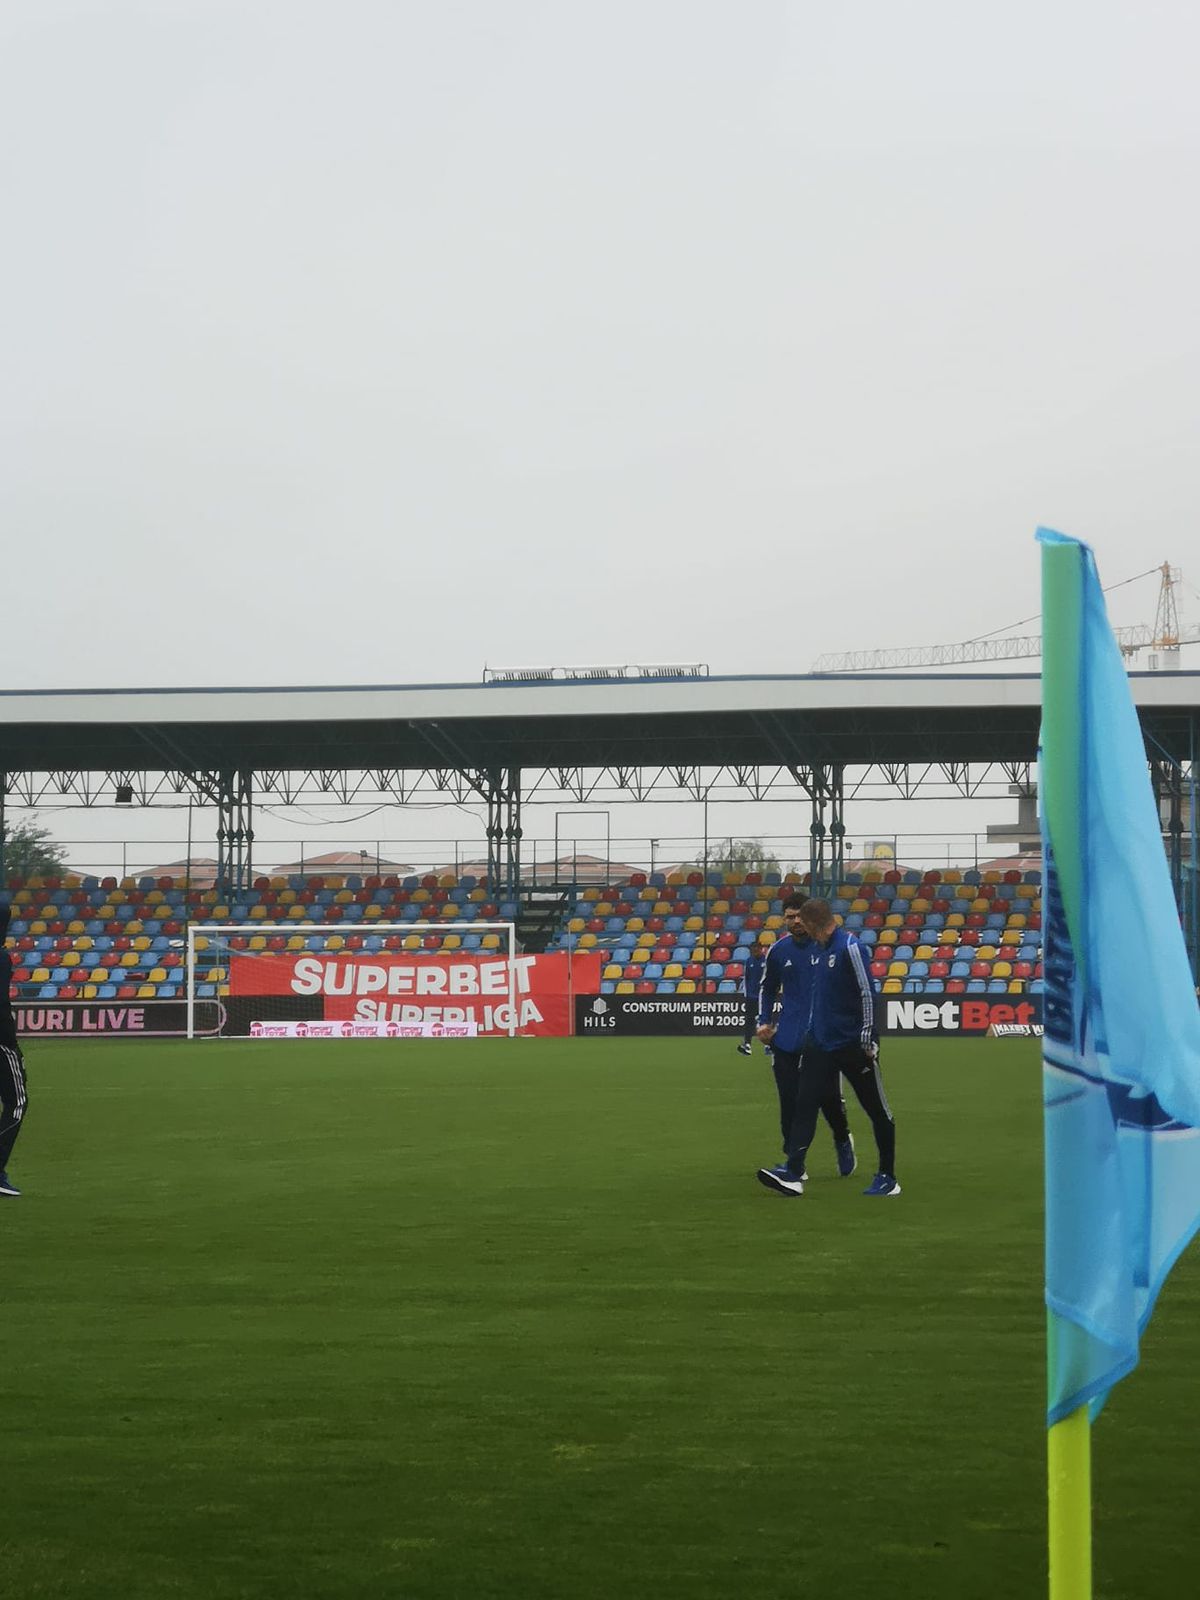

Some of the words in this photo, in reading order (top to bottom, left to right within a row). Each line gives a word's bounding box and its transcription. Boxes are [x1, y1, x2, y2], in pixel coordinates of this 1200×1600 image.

[290, 956, 537, 996] SUPERBET
[354, 999, 544, 1031] SUPERLIGA
[622, 1002, 691, 1013] CONSTRUIM
[693, 1002, 738, 1013] PENTRU
[887, 1000, 1035, 1030] NetBet
[82, 1008, 145, 1030] LIVE
[584, 1016, 616, 1027] HILS
[693, 1015, 714, 1026] DIN
[716, 1015, 746, 1027] 2005
